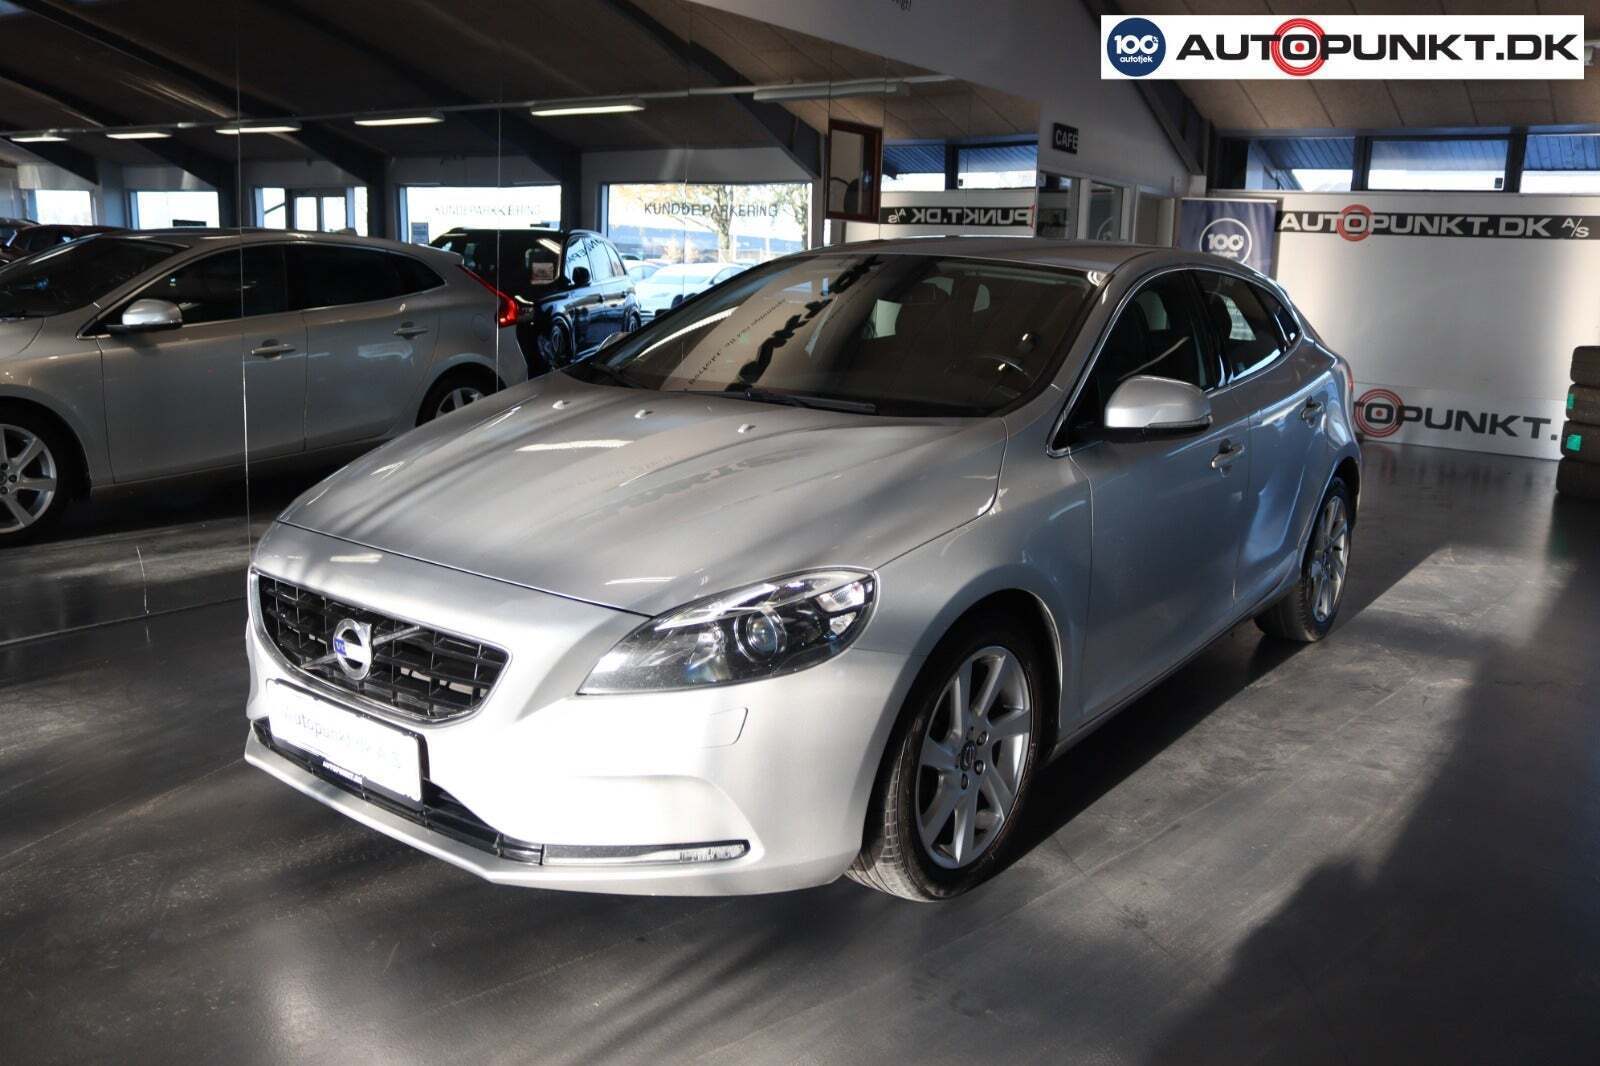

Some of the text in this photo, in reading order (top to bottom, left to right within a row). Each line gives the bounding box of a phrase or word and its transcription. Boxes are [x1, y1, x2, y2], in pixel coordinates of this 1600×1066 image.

[1279, 212, 1591, 239] AUTOPUNKT.DK A/S
[1354, 401, 1558, 441] OPUNKT.
